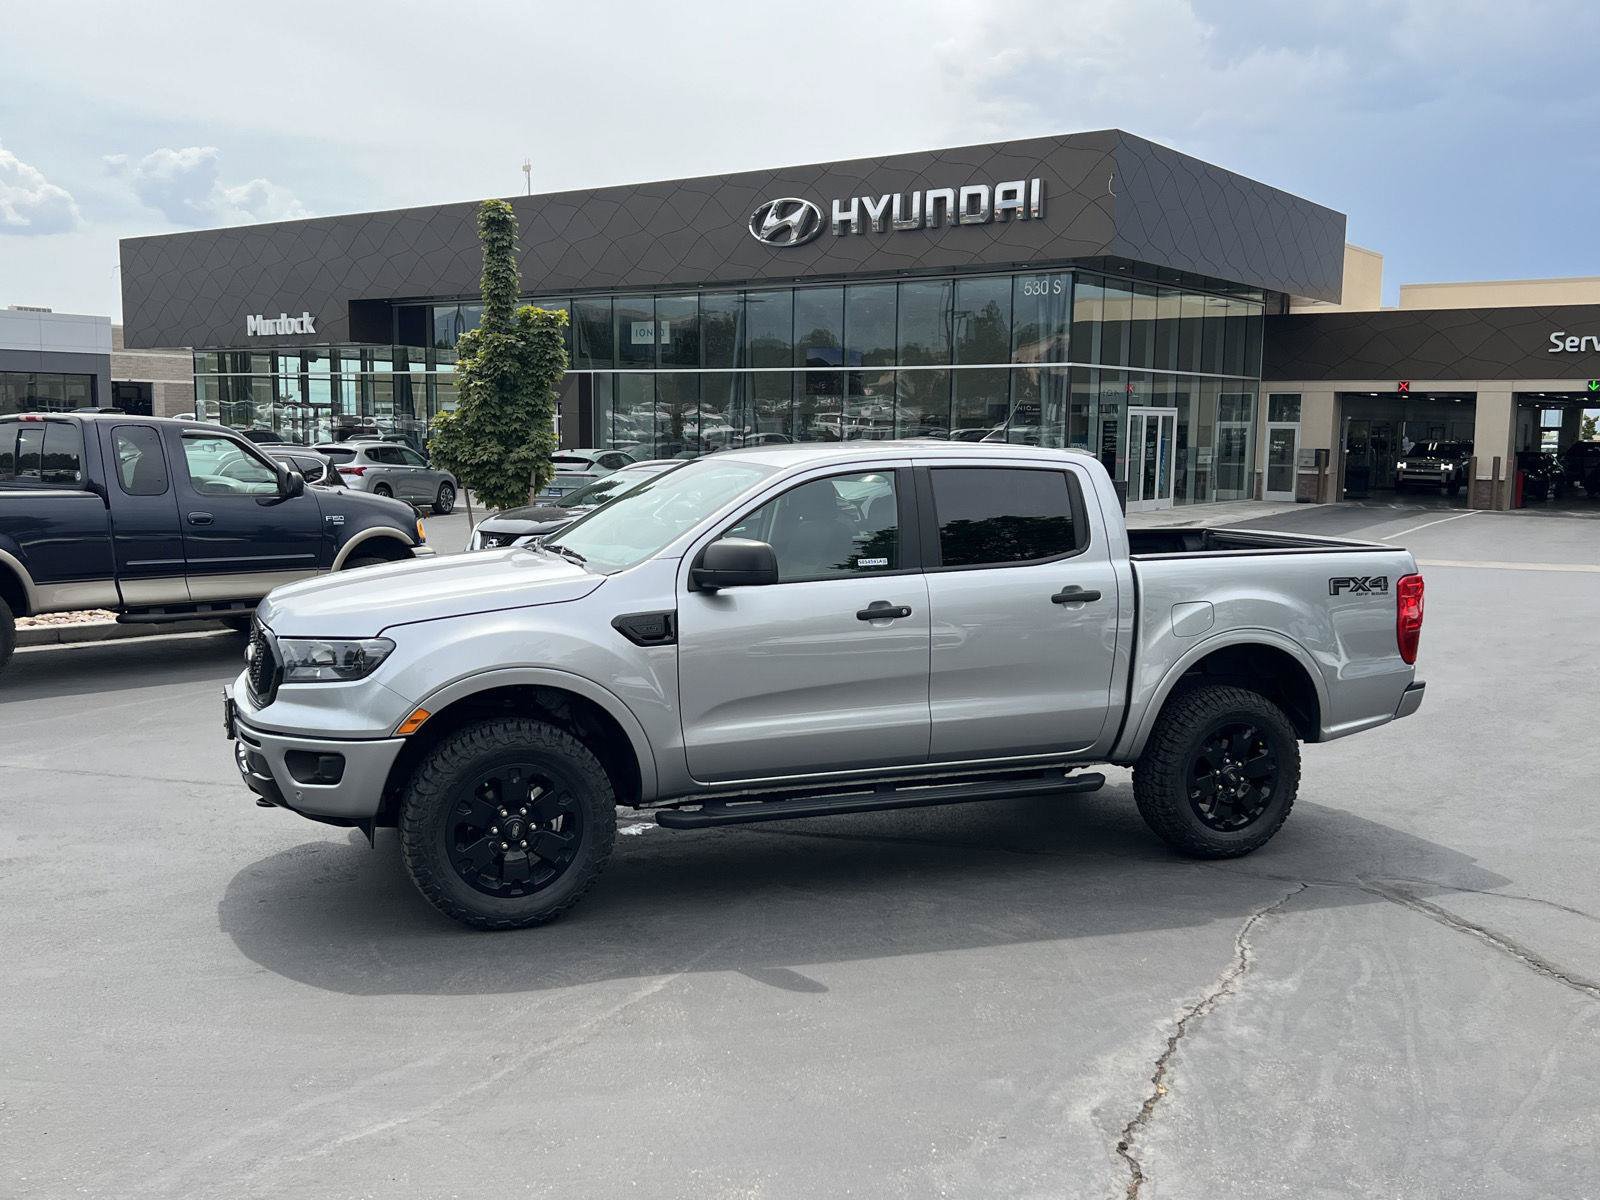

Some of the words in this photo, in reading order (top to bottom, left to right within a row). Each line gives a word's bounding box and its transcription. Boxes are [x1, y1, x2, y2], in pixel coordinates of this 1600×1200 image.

[832, 178, 1043, 236] HYUNDAI
[1024, 280, 1049, 295] 530
[1053, 279, 1061, 294] S
[247, 312, 316, 336] Murdock
[1329, 576, 1389, 595] FX4
